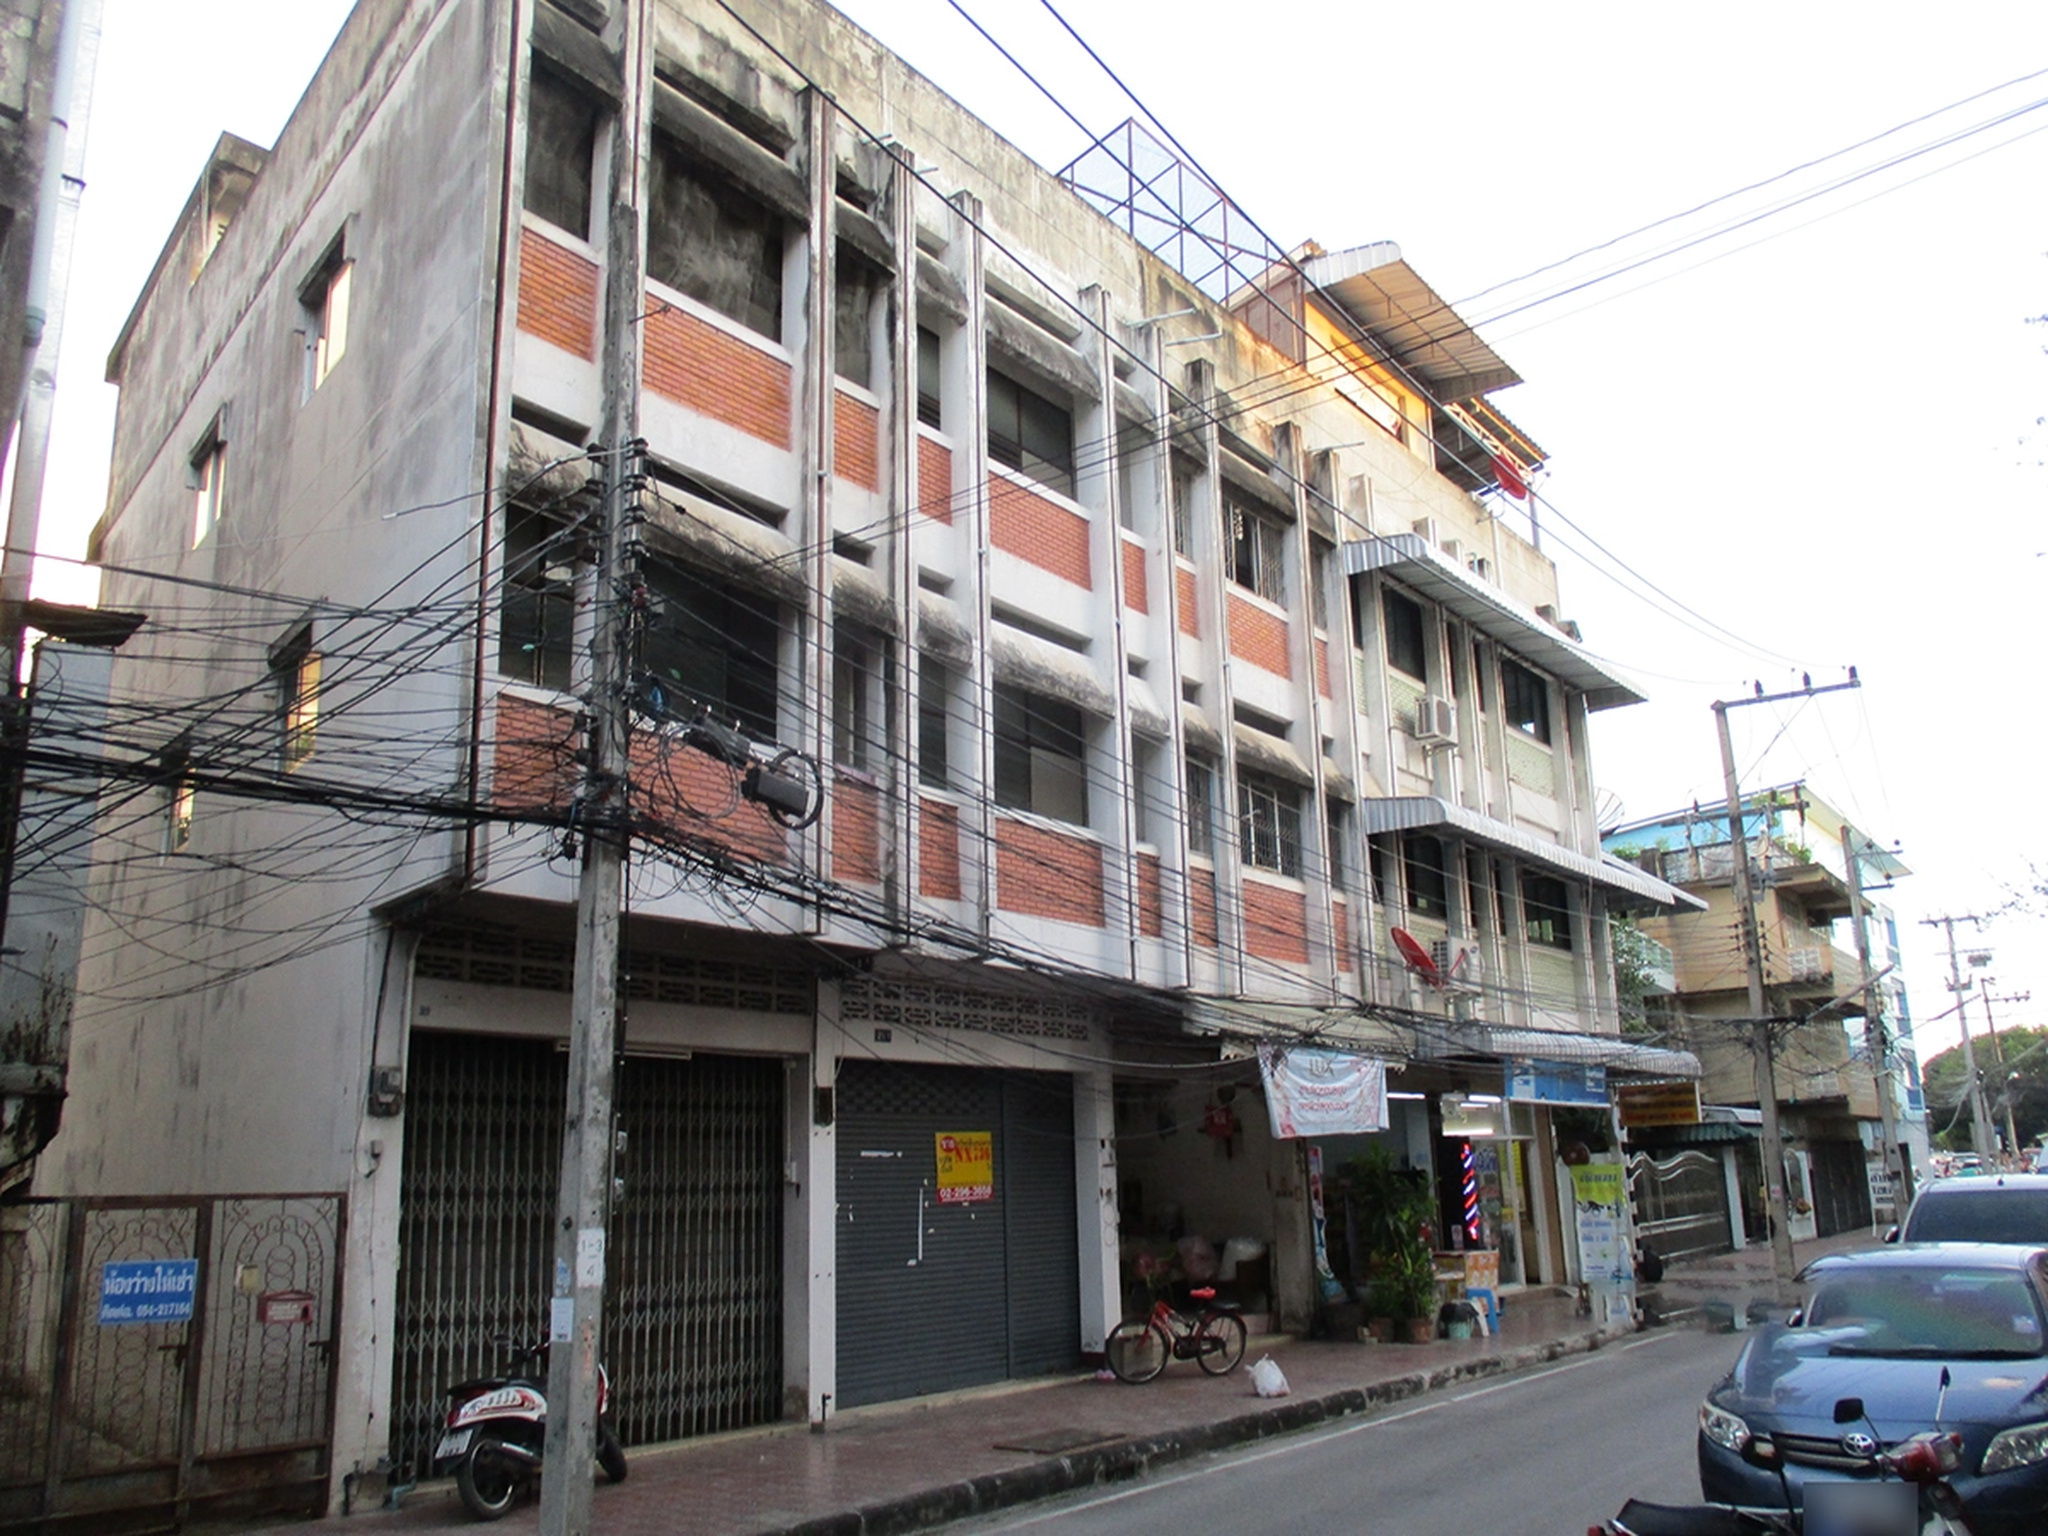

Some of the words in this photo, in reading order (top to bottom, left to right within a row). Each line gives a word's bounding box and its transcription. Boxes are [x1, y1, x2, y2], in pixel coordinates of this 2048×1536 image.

[1309, 1058, 1335, 1078] LUX
[104, 1265, 193, 1295] ห้องว่างให้เช่า
